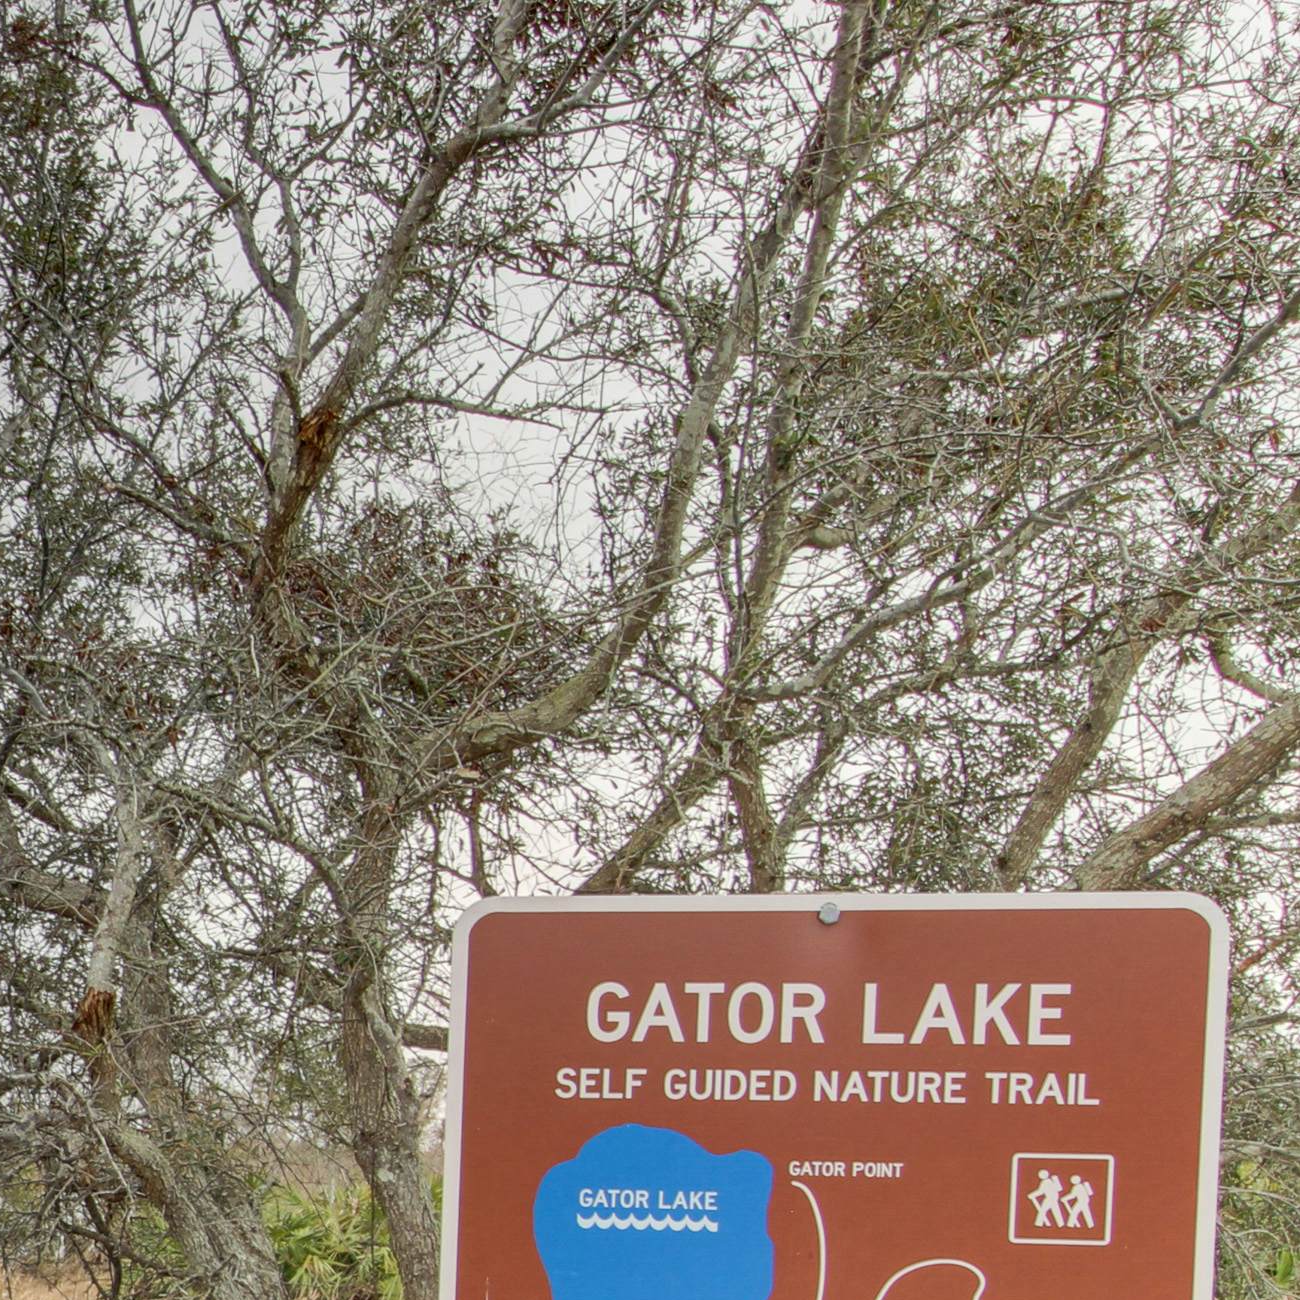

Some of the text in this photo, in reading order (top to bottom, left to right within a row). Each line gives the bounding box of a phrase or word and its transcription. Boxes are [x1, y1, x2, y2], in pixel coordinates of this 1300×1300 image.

[586, 981, 1072, 1046] GATOR LAKE
[554, 1067, 1101, 1106] SELF GUIDED NATURE TRAIL
[788, 1160, 904, 1178] GATOR POINT
[578, 1187, 719, 1211] GATOR LAKE
